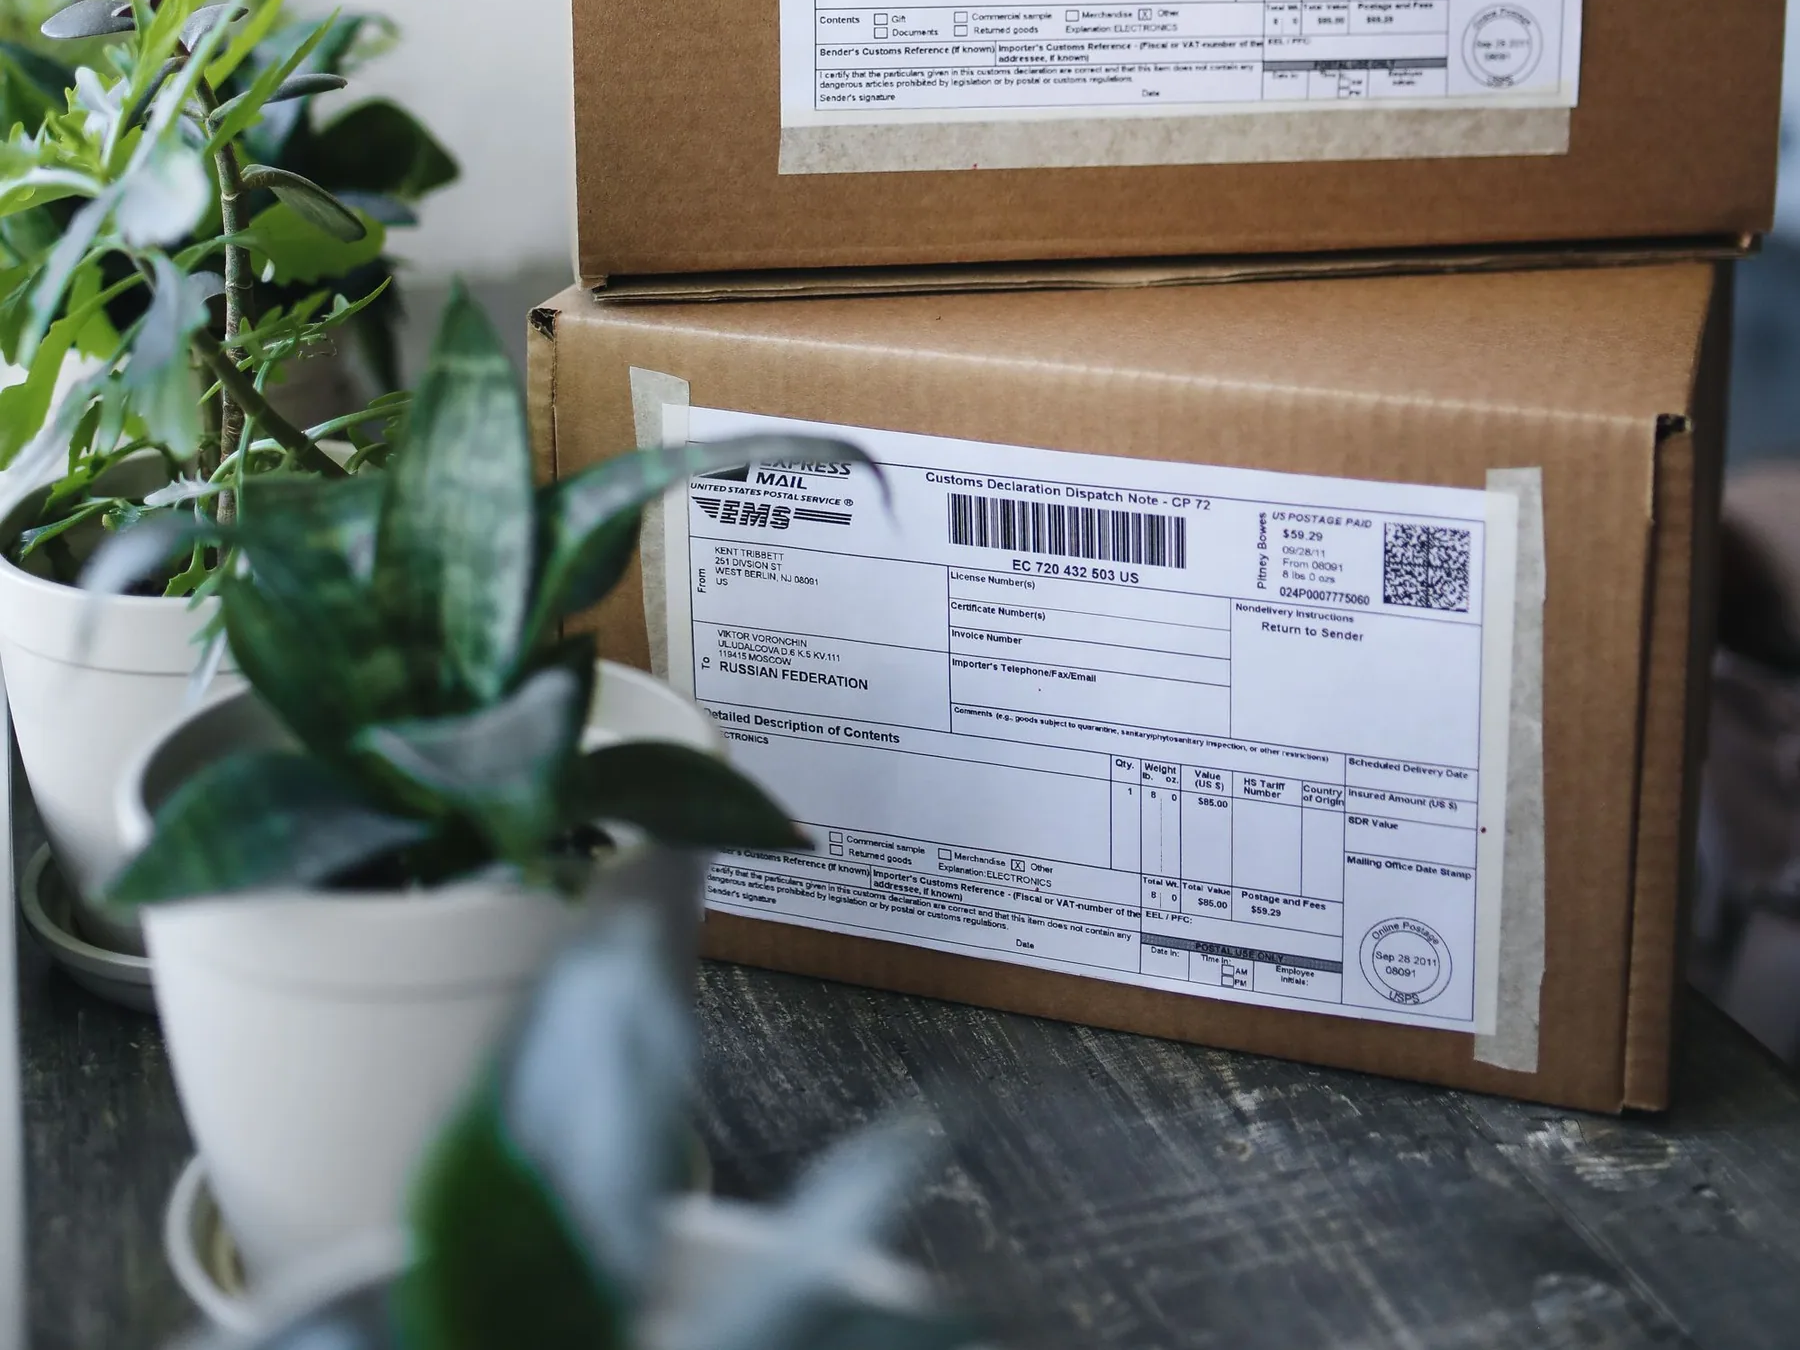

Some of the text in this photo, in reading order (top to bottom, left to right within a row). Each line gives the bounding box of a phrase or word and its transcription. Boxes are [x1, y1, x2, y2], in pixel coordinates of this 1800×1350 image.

[819, 16, 860, 24] Contents
[891, 15, 906, 23] Gift
[972, 12, 1052, 22] Commercial sample
[892, 28, 939, 37] Documents
[974, 26, 1038, 34] Returned goods
[756, 472, 807, 489] MAIL
[690, 483, 841, 506] UNITED STATES POSTAL SERVICE
[926, 471, 1210, 511] Customs Declaration Dispatch Note CP 72
[719, 500, 791, 530] EMS
[1272, 512, 1372, 529] US POSTAGE PAID
[1282, 529, 1323, 542] $59.29
[715, 546, 784, 561] KENT TRIBBETT
[1257, 512, 1269, 589] Pitney Bowes
[1282, 546, 1325, 558] 09/28/11
[715, 557, 782, 571] 251 DIVSION ST
[1012, 559, 1139, 584] EC 720 432 503 US
[1283, 559, 1343, 572] From 08091
[698, 568, 706, 592] From
[716, 567, 819, 586] WEST BERLIN, NJ 08091
[716, 578, 728, 586] US
[950, 572, 1035, 590] License Number(s)
[1279, 586, 1370, 606] 024P0007775060
[950, 602, 1046, 621] Certificate Number(s)
[1236, 603, 1354, 623] Nondelivery Instructions
[718, 629, 807, 648] VIKTOR VORONCHIN
[951, 629, 1022, 645] Invoice Number
[1262, 621, 1364, 641] Return to Sender
[701, 657, 710, 669] To
[719, 650, 791, 666] 119415 MOSCOW
[720, 661, 868, 690] RUSSIAN FEDERATION
[952, 658, 1096, 682] Importer's Telephone/Fax/Email
[754, 715, 900, 744] Description of Contents
[1194, 770, 1221, 781] Value
[1348, 758, 1468, 779] Scheduled Delivery Date
[1244, 787, 1281, 799] Number
[1348, 789, 1426, 806] Insured Amount
[1198, 797, 1228, 809] $85.00
[1348, 816, 1398, 830] SDR Value
[847, 835, 925, 855] Commercial sample
[849, 849, 912, 865] Returned goods
[954, 852, 1006, 867] Merchandise
[1030, 863, 1053, 874] Other
[1347, 856, 1471, 880] Mailing Office Date Stamp
[1198, 898, 1228, 909] $85.00
[1242, 891, 1326, 911] Postage and Fees
[1251, 905, 1282, 917] $59.29
[1372, 921, 1440, 945] Online Postage
[1016, 939, 1035, 949] Date
[1376, 951, 1436, 966] Sep 28 2011
[1386, 966, 1416, 978] 08091
[1389, 991, 1420, 1004] USPS
